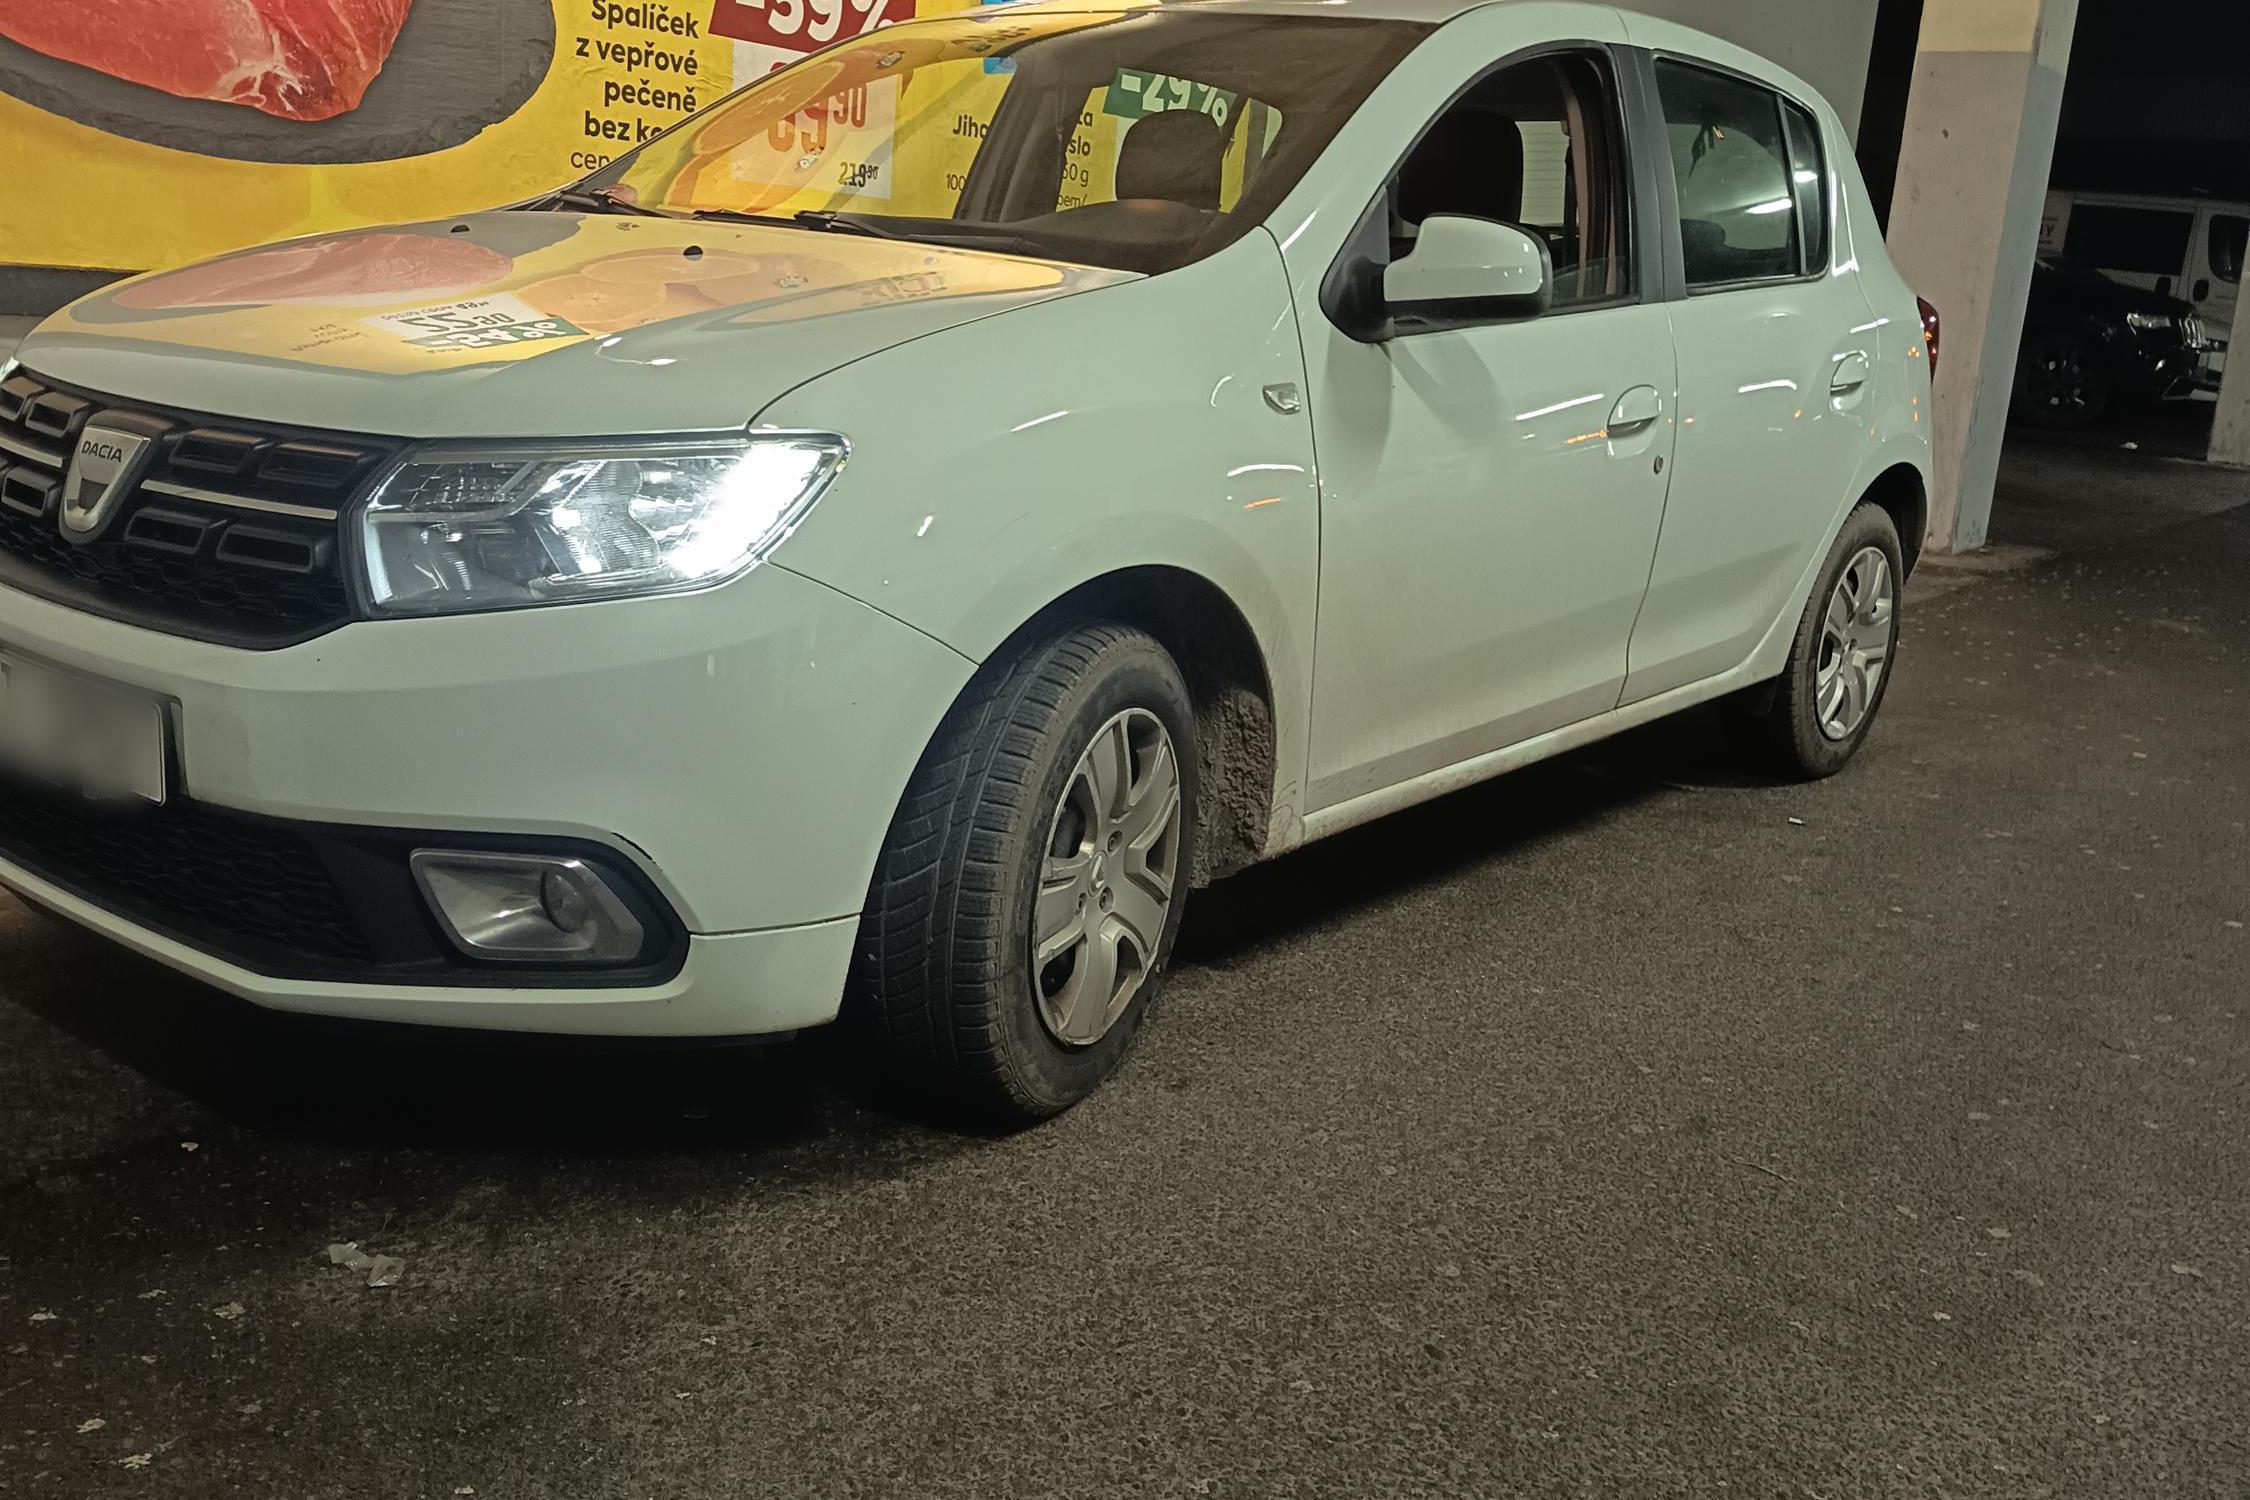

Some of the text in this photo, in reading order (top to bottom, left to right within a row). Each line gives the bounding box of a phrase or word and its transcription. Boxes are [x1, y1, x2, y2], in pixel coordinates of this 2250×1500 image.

[591, 0, 699, 39] Spalíček
[575, 36, 698, 76] z vepřové
[604, 78, 697, 113] pečeně
[584, 110, 630, 142] bez
[81, 440, 122, 462] DACIA
